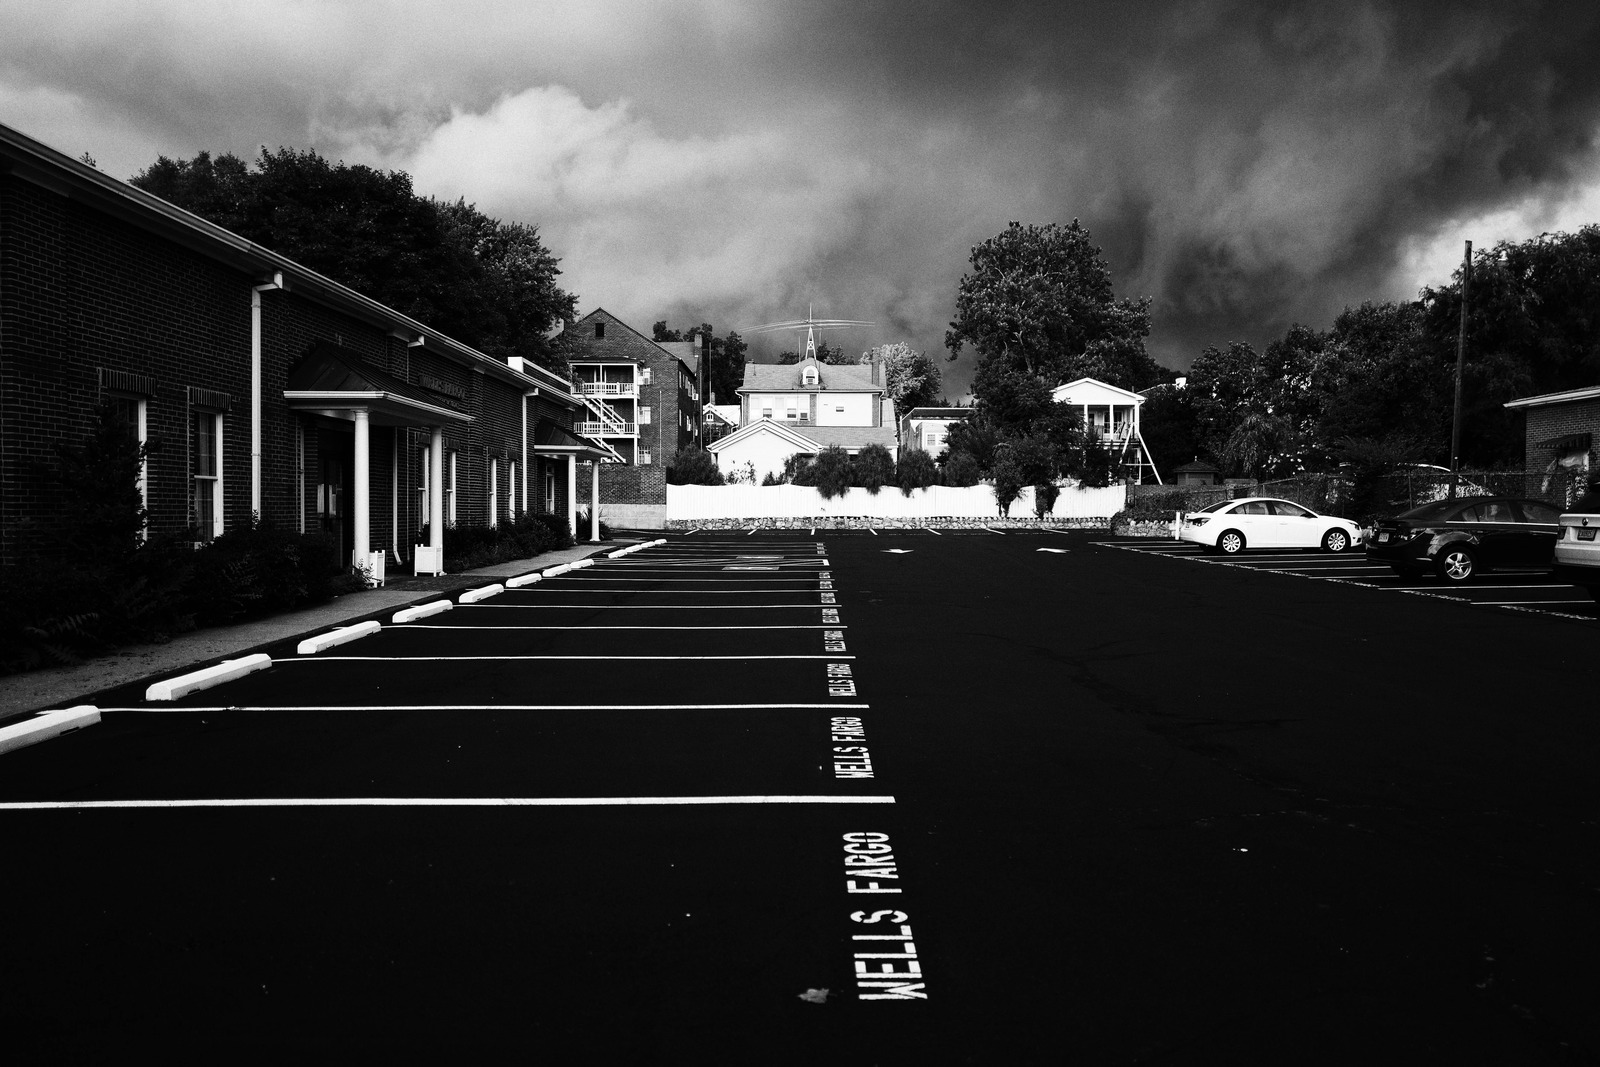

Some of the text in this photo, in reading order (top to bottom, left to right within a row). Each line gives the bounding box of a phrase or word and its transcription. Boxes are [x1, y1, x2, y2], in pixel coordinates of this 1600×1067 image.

[831, 716, 874, 778] WELLS FARGO
[842, 832, 928, 1000] WELLS FARGO
